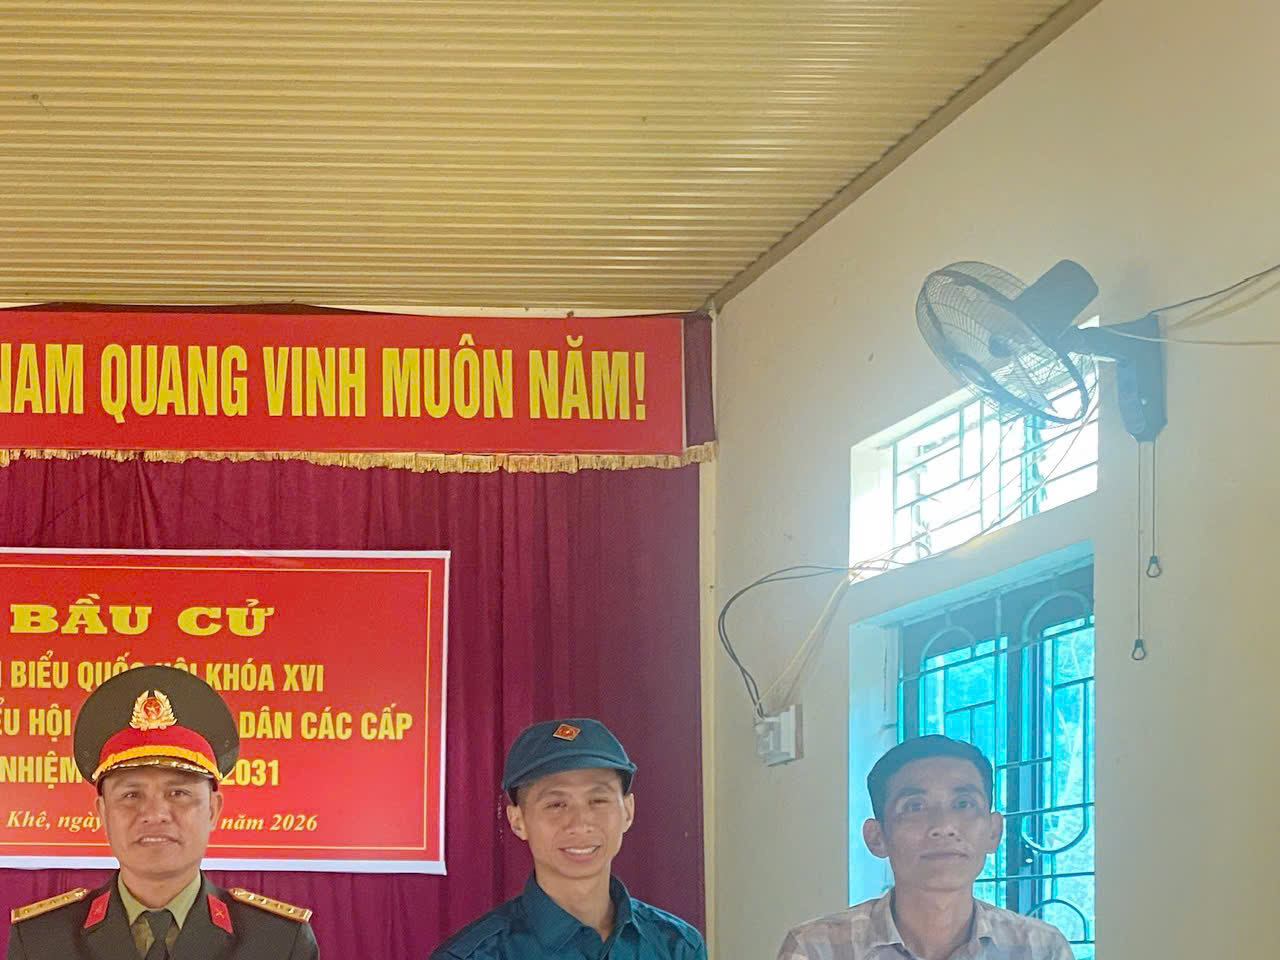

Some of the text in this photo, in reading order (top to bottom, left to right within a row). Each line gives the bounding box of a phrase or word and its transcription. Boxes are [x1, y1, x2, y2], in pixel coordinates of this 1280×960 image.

[100, 344, 248, 424] QUANG
[263, 347, 366, 418] VINH
[382, 333, 514, 419] MUÔN
[529, 334, 646, 421] NĂM!
[10, 591, 276, 637] BẦU CỬ
[11, 649, 69, 689] BIỂU
[206, 657, 275, 692] KHÓA
[283, 663, 324, 692] XVI
[29, 703, 71, 743] HỘI
[239, 703, 413, 740] DÂN CÁC CẤP
[0, 751, 83, 789] NHIỆM
[7, 810, 51, 830] Khê,
[57, 811, 101, 833] ngày
[221, 813, 318, 831] năm 2026
